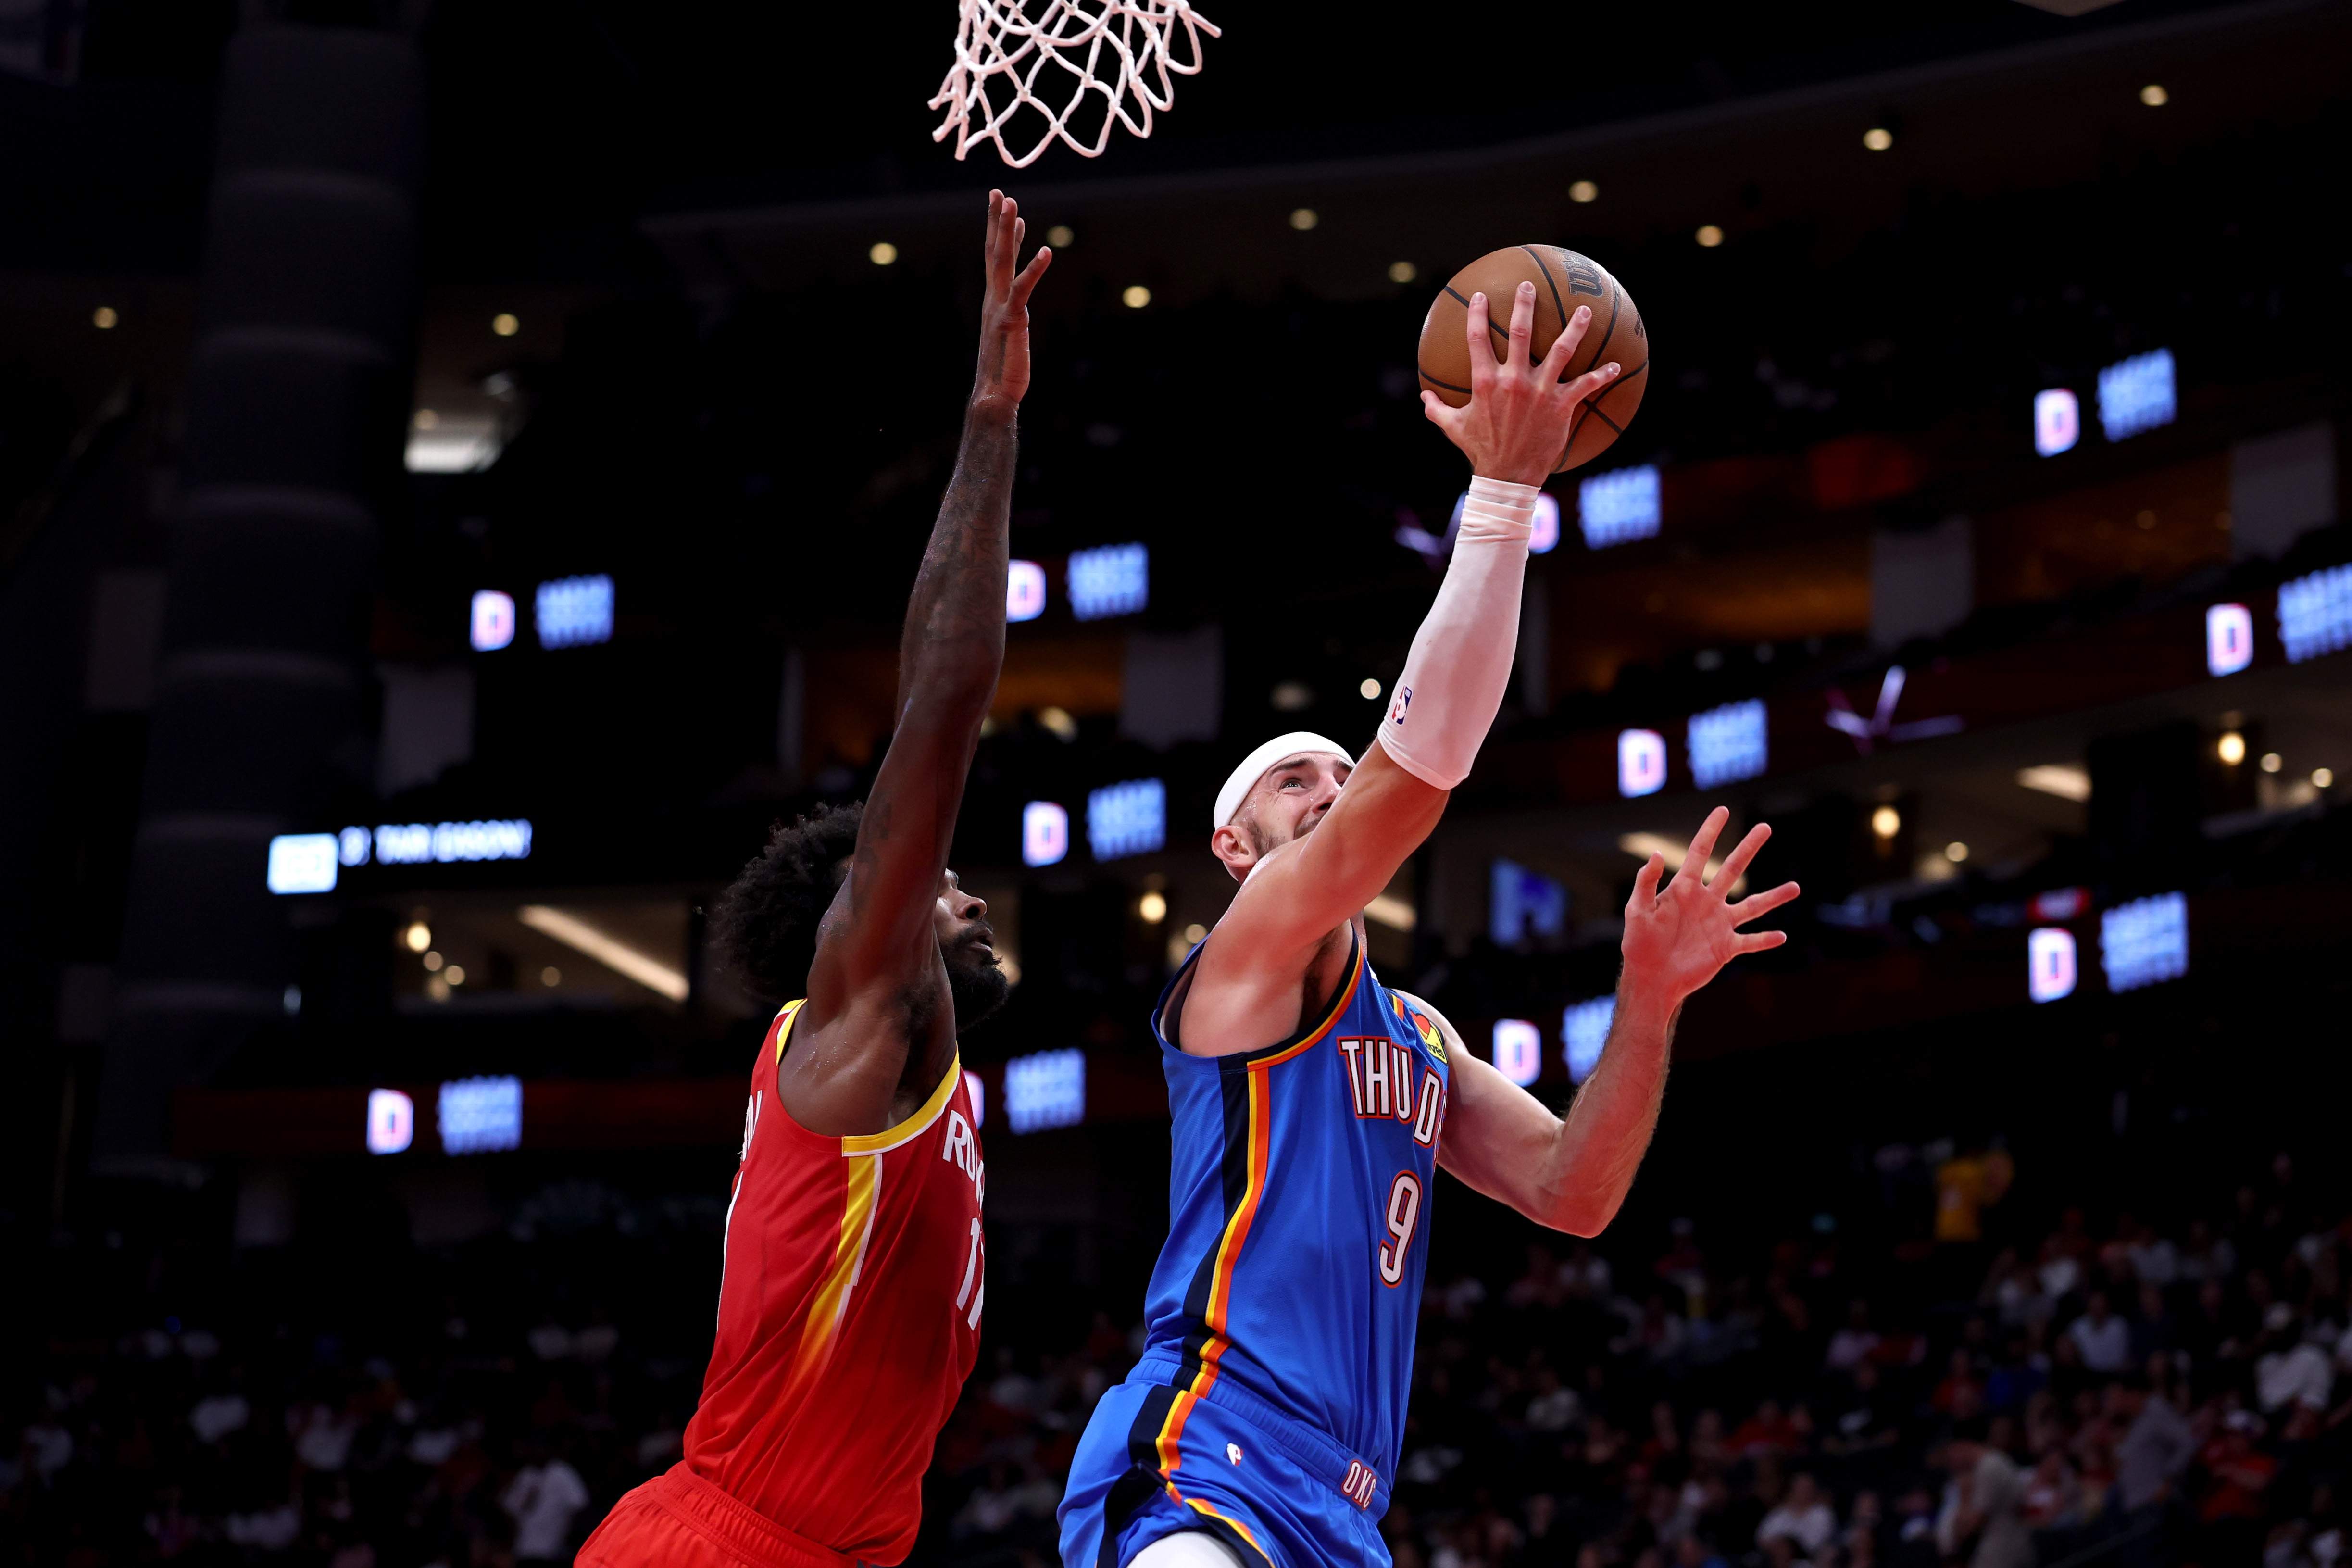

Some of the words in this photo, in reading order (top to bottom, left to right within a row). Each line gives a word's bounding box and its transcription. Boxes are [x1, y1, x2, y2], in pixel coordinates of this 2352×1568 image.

[1337, 1036, 1446, 1172] THUD
[1378, 1170, 1422, 1289] 9
[1341, 1460, 1377, 1510] OKC
